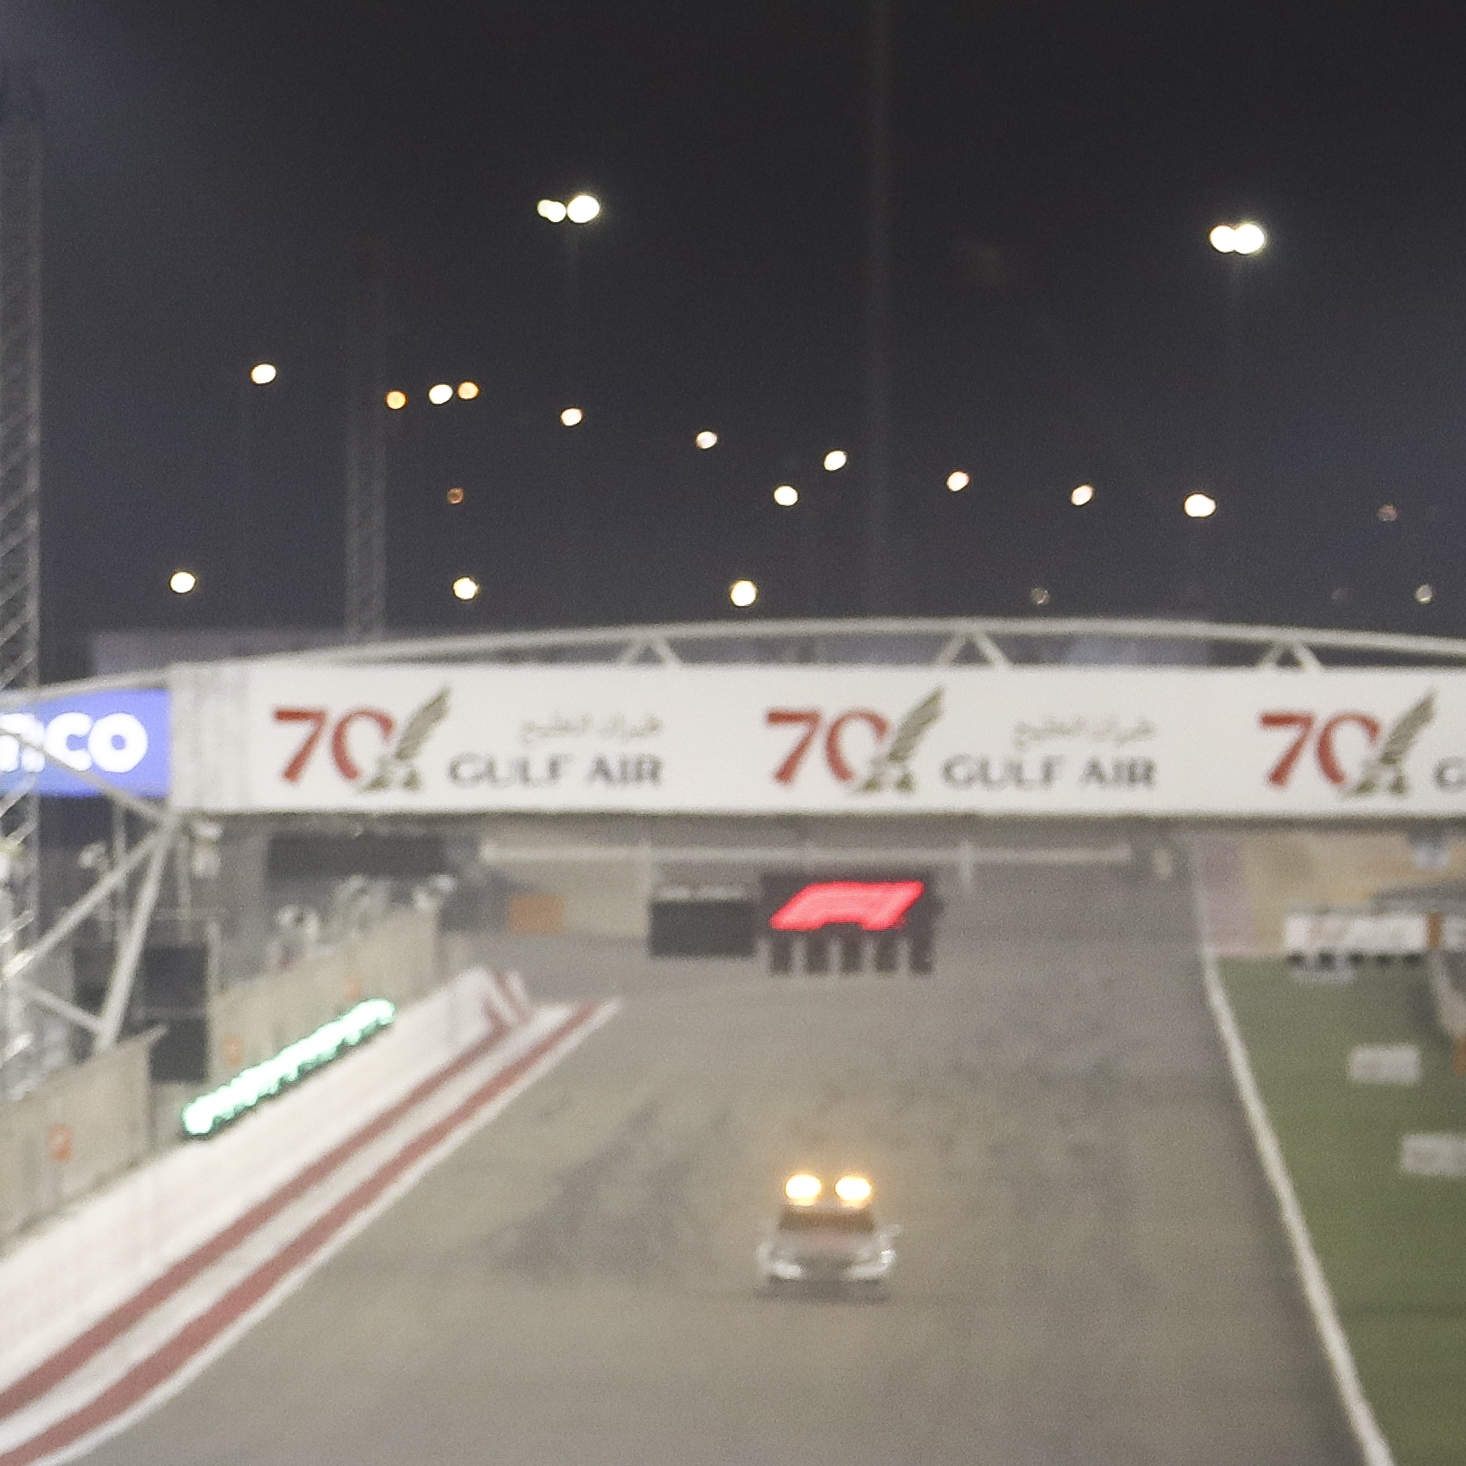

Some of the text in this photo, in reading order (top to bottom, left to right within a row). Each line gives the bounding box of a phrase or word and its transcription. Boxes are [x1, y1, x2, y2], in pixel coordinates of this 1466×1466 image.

[447, 752, 664, 788] GULF AIR
[941, 754, 1157, 790] GULF AIR
